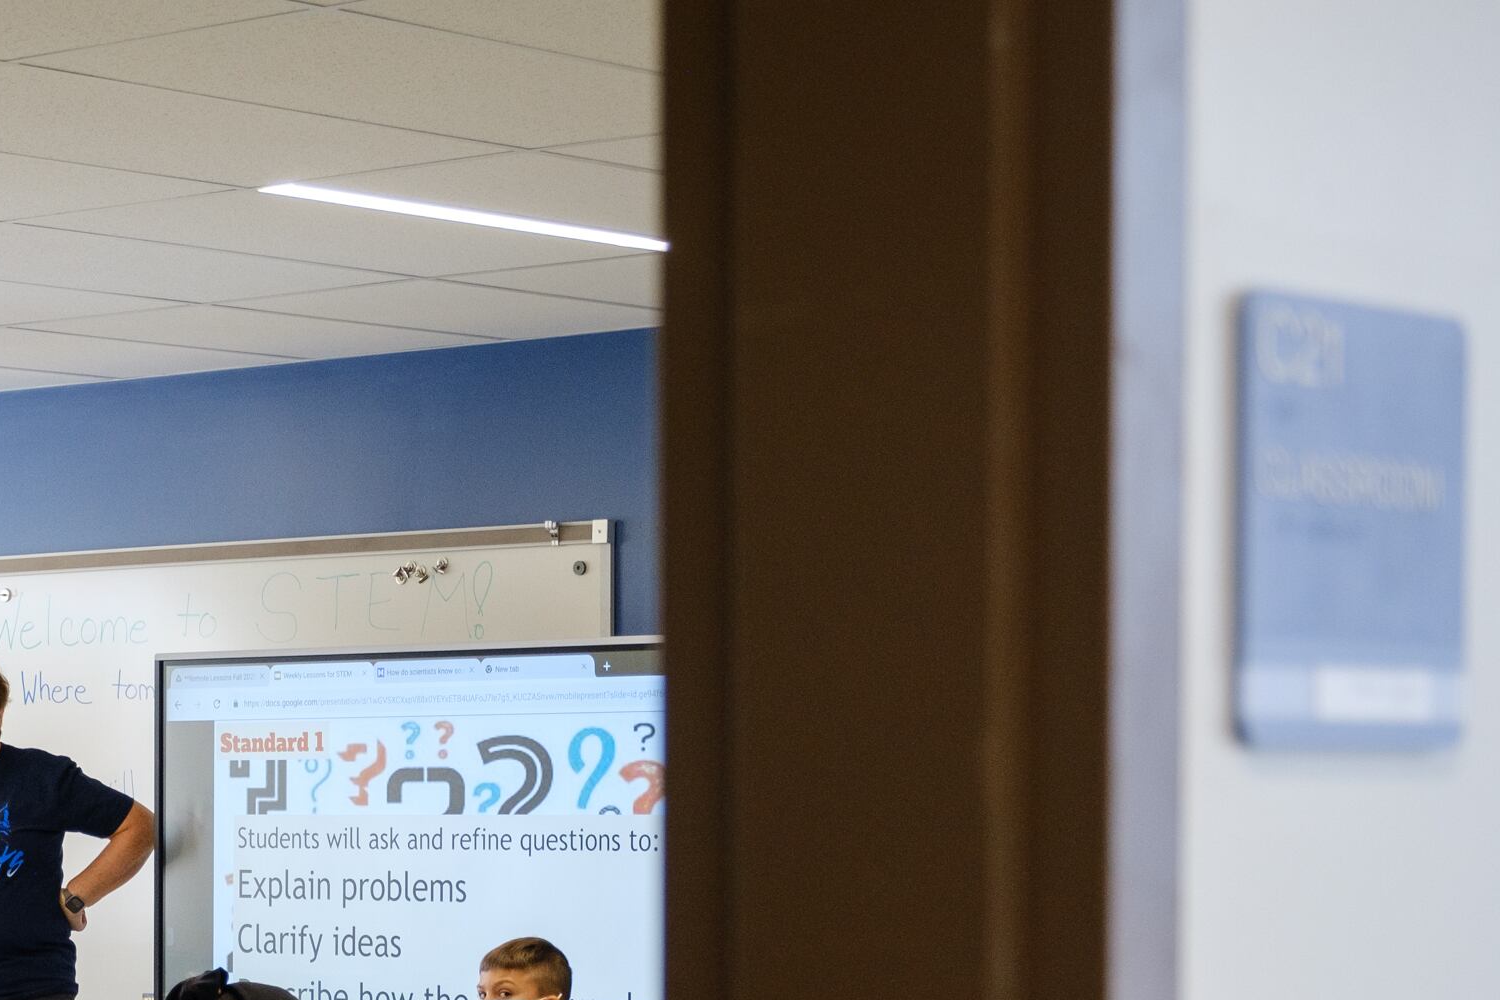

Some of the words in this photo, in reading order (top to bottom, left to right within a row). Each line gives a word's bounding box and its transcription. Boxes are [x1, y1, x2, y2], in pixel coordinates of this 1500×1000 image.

[178, 593, 217, 639] to
[283, 671, 302, 681] Weekly
[303, 670, 326, 680] Lessons
[327, 670, 336, 678] for
[336, 669, 353, 679] STEM
[386, 668, 399, 677] How
[401, 667, 409, 676] do
[409, 666, 437, 676] scientists
[437, 665, 453, 675] know
[494, 664, 508, 673] New
[509, 664, 520, 673] tab
[20, 670, 93, 705] Where
[111, 669, 155, 702] tom
[220, 731, 311, 754] Standard
[313, 731, 325, 752] 1
[237, 826, 320, 851] Students
[327, 826, 361, 851] will
[368, 827, 401, 851] ask
[407, 827, 444, 852] and
[451, 827, 513, 852] refine
[520, 829, 622, 857] questions
[628, 830, 659, 853] to:
[237, 868, 332, 907] Explain
[342, 869, 468, 908] problems
[237, 923, 324, 962] Clarify
[333, 926, 403, 958] ideas
